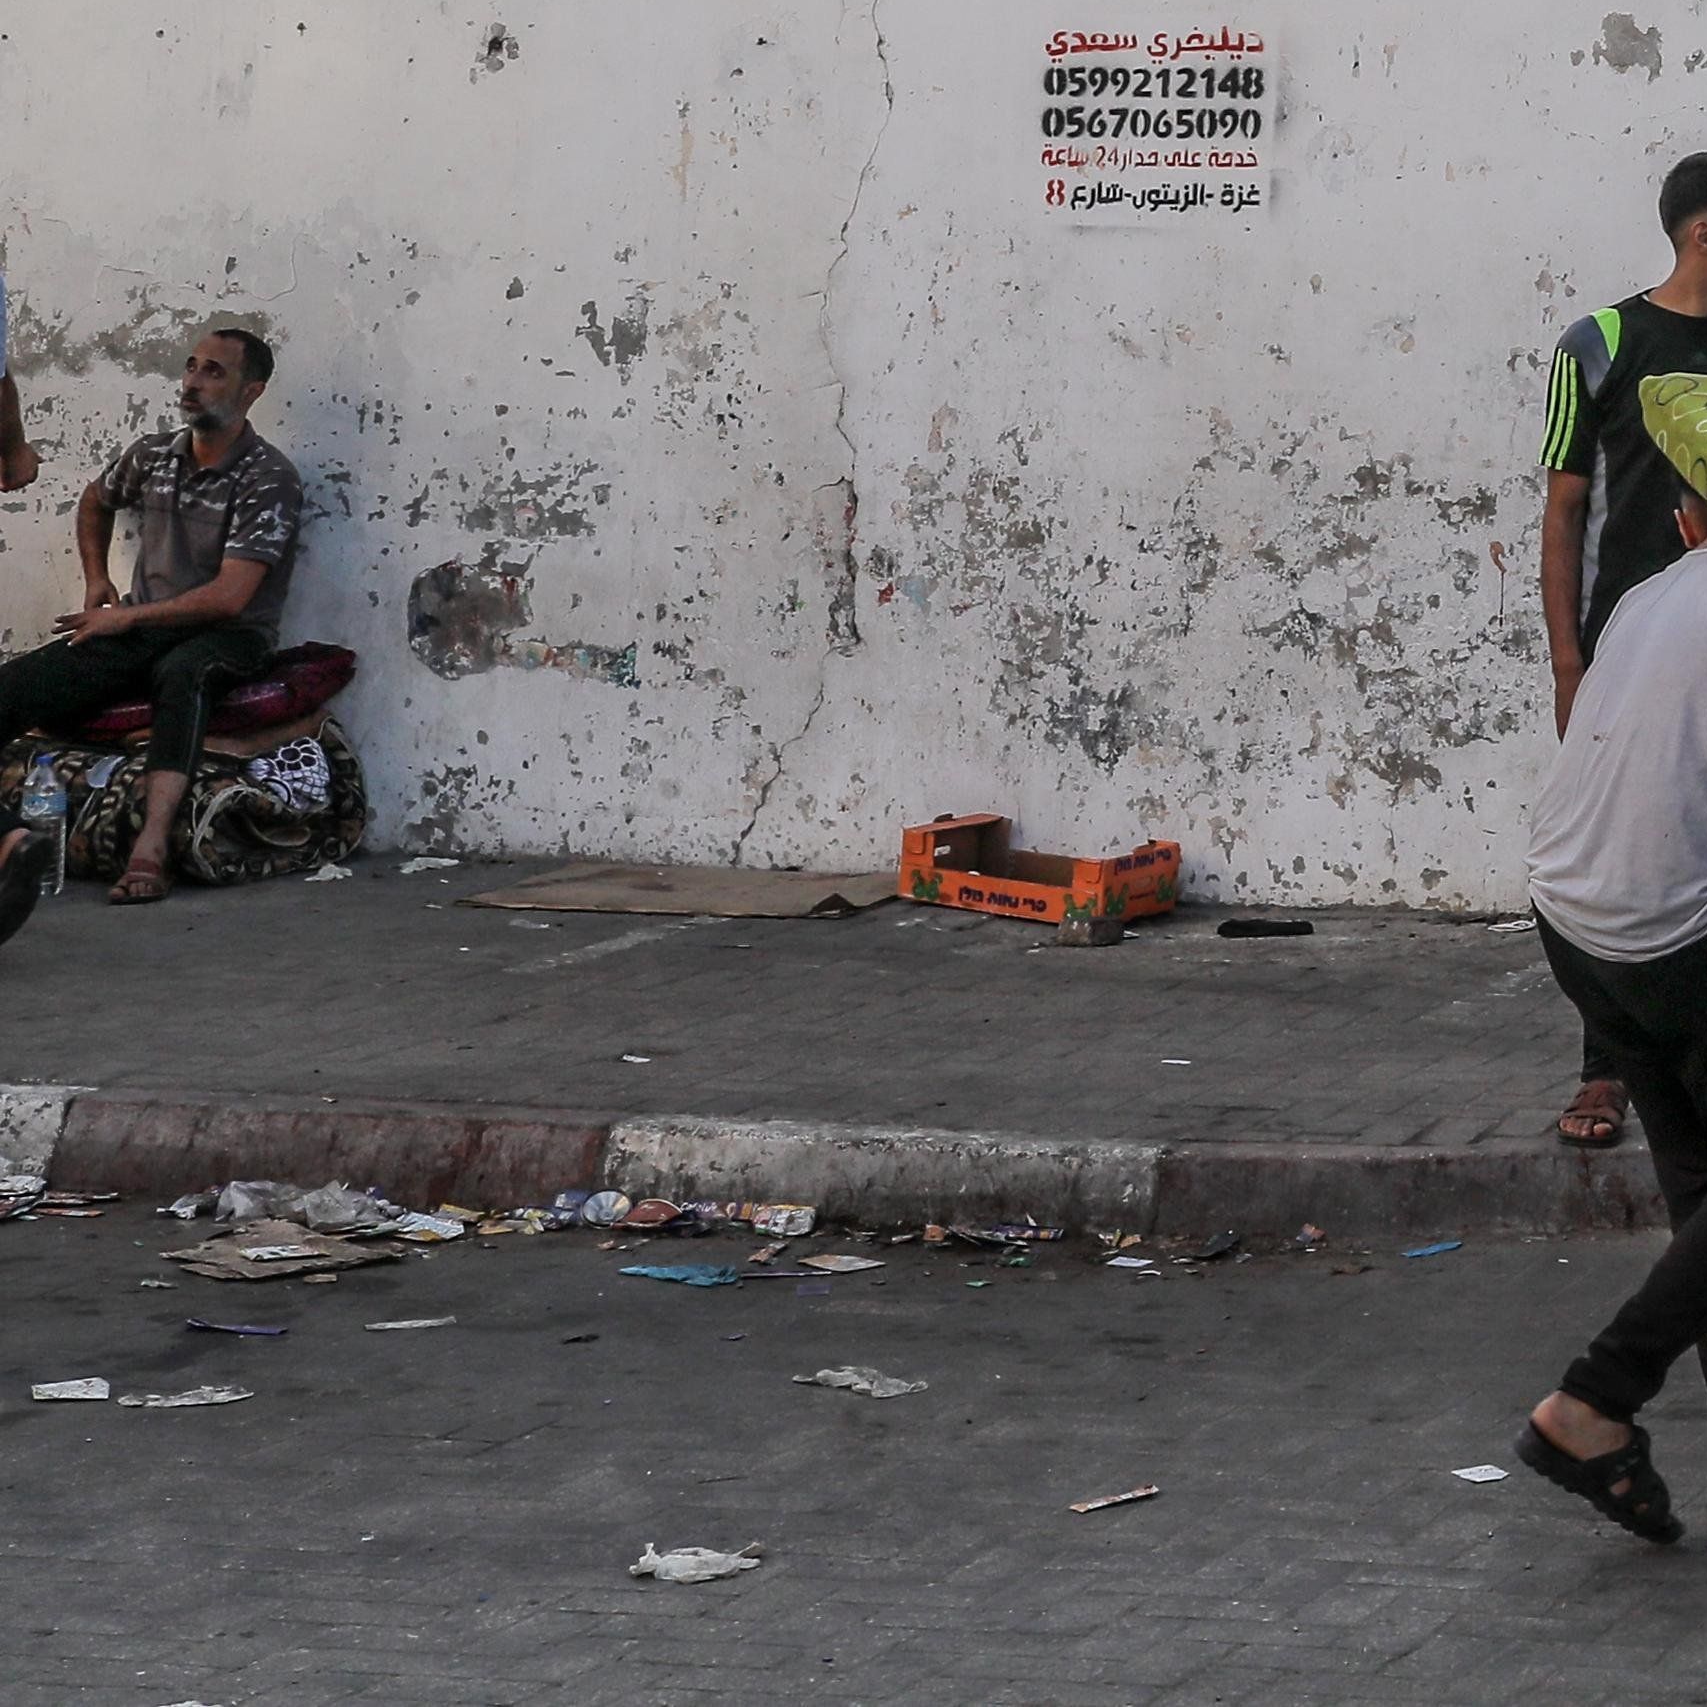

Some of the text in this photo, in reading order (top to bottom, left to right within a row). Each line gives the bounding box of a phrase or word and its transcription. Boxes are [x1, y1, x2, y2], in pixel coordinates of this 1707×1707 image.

[1045, 31, 1138, 63] سعدي
[1043, 66, 1264, 99] 0599212148
[1041, 106, 1262, 139] 0567065090
[1041, 143, 1089, 167] ساعة
[1095, 146, 1119, 170] 24
[1164, 147, 1202, 168] على
[1207, 145, 1258, 168] خدمة
[1046, 179, 1066, 206] 8
[1220, 183, 1261, 213] غزة
